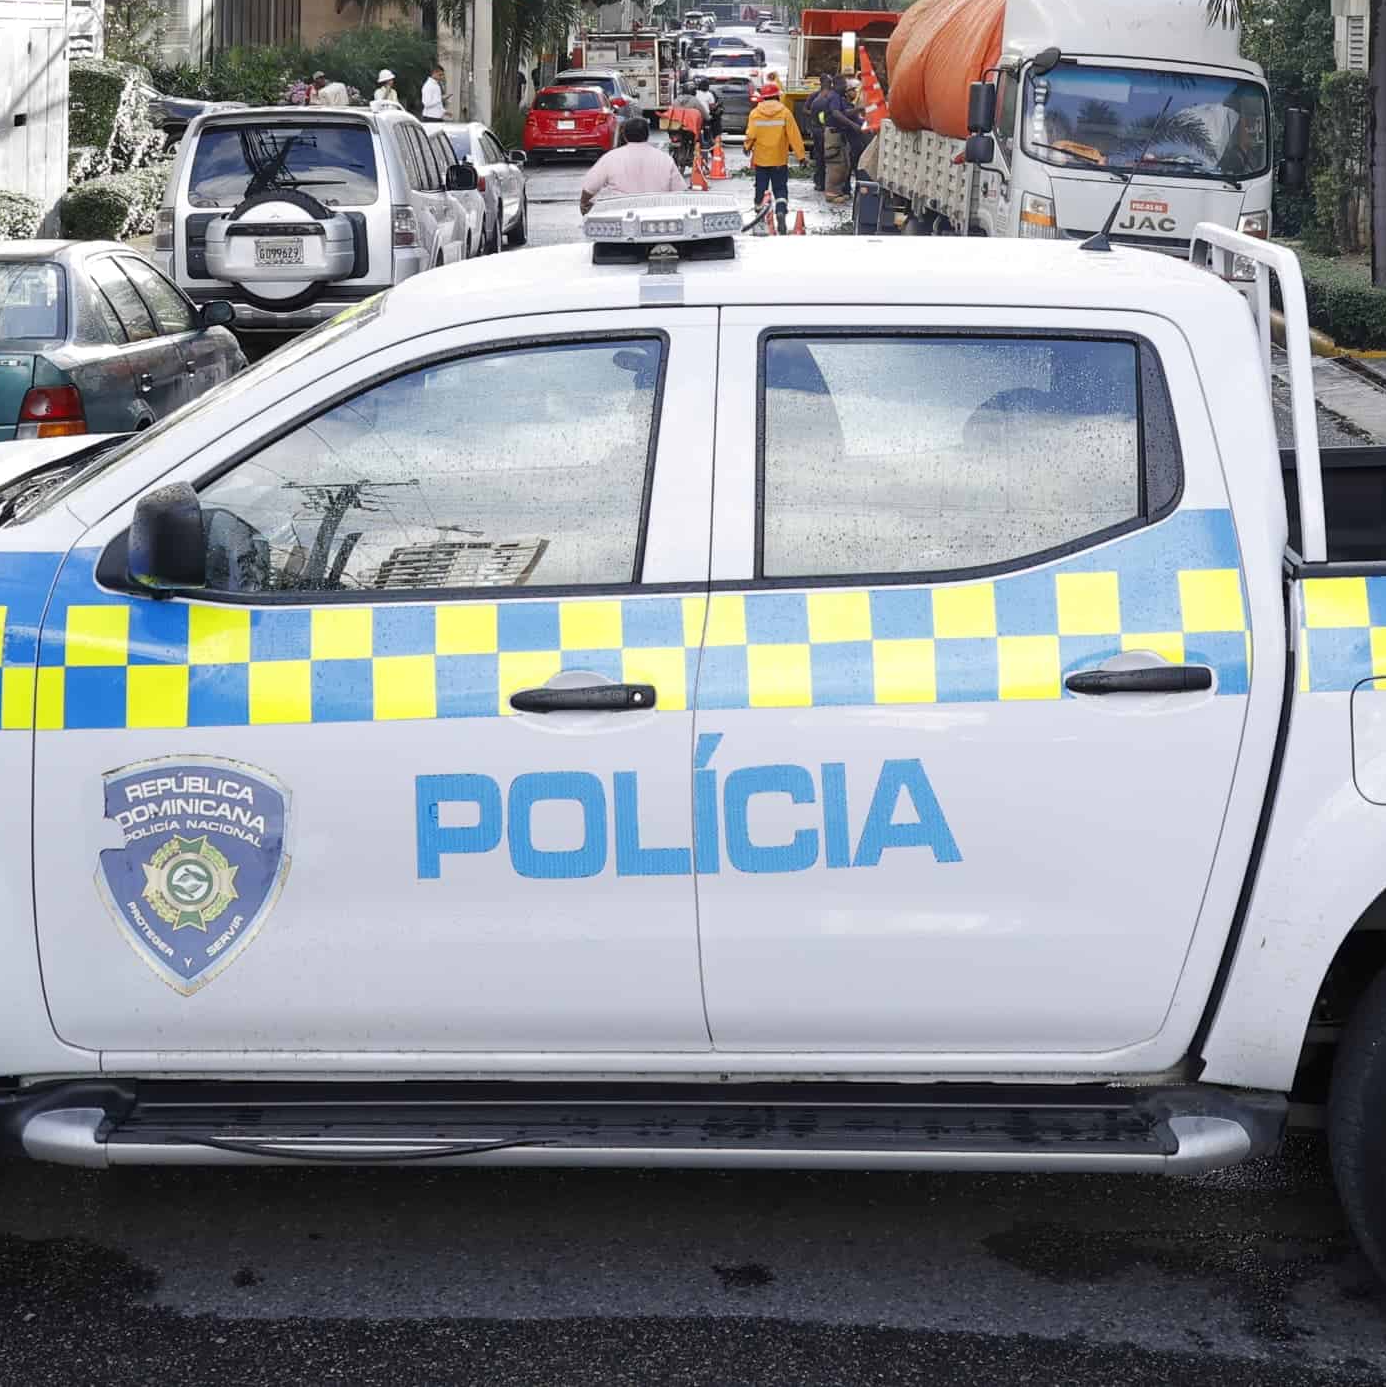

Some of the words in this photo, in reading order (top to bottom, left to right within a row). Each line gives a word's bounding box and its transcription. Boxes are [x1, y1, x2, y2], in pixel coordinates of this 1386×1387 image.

[1118, 215, 1176, 232] JAC
[124, 772, 255, 805] REPÚBLICA
[414, 732, 963, 880] POLÍCIA
[115, 797, 265, 834] DOMINICANA
[185, 819, 263, 849] NACIONAL
[126, 900, 175, 958] PROTEGER
[183, 956, 195, 968] Y
[205, 913, 245, 958] SERVIR
